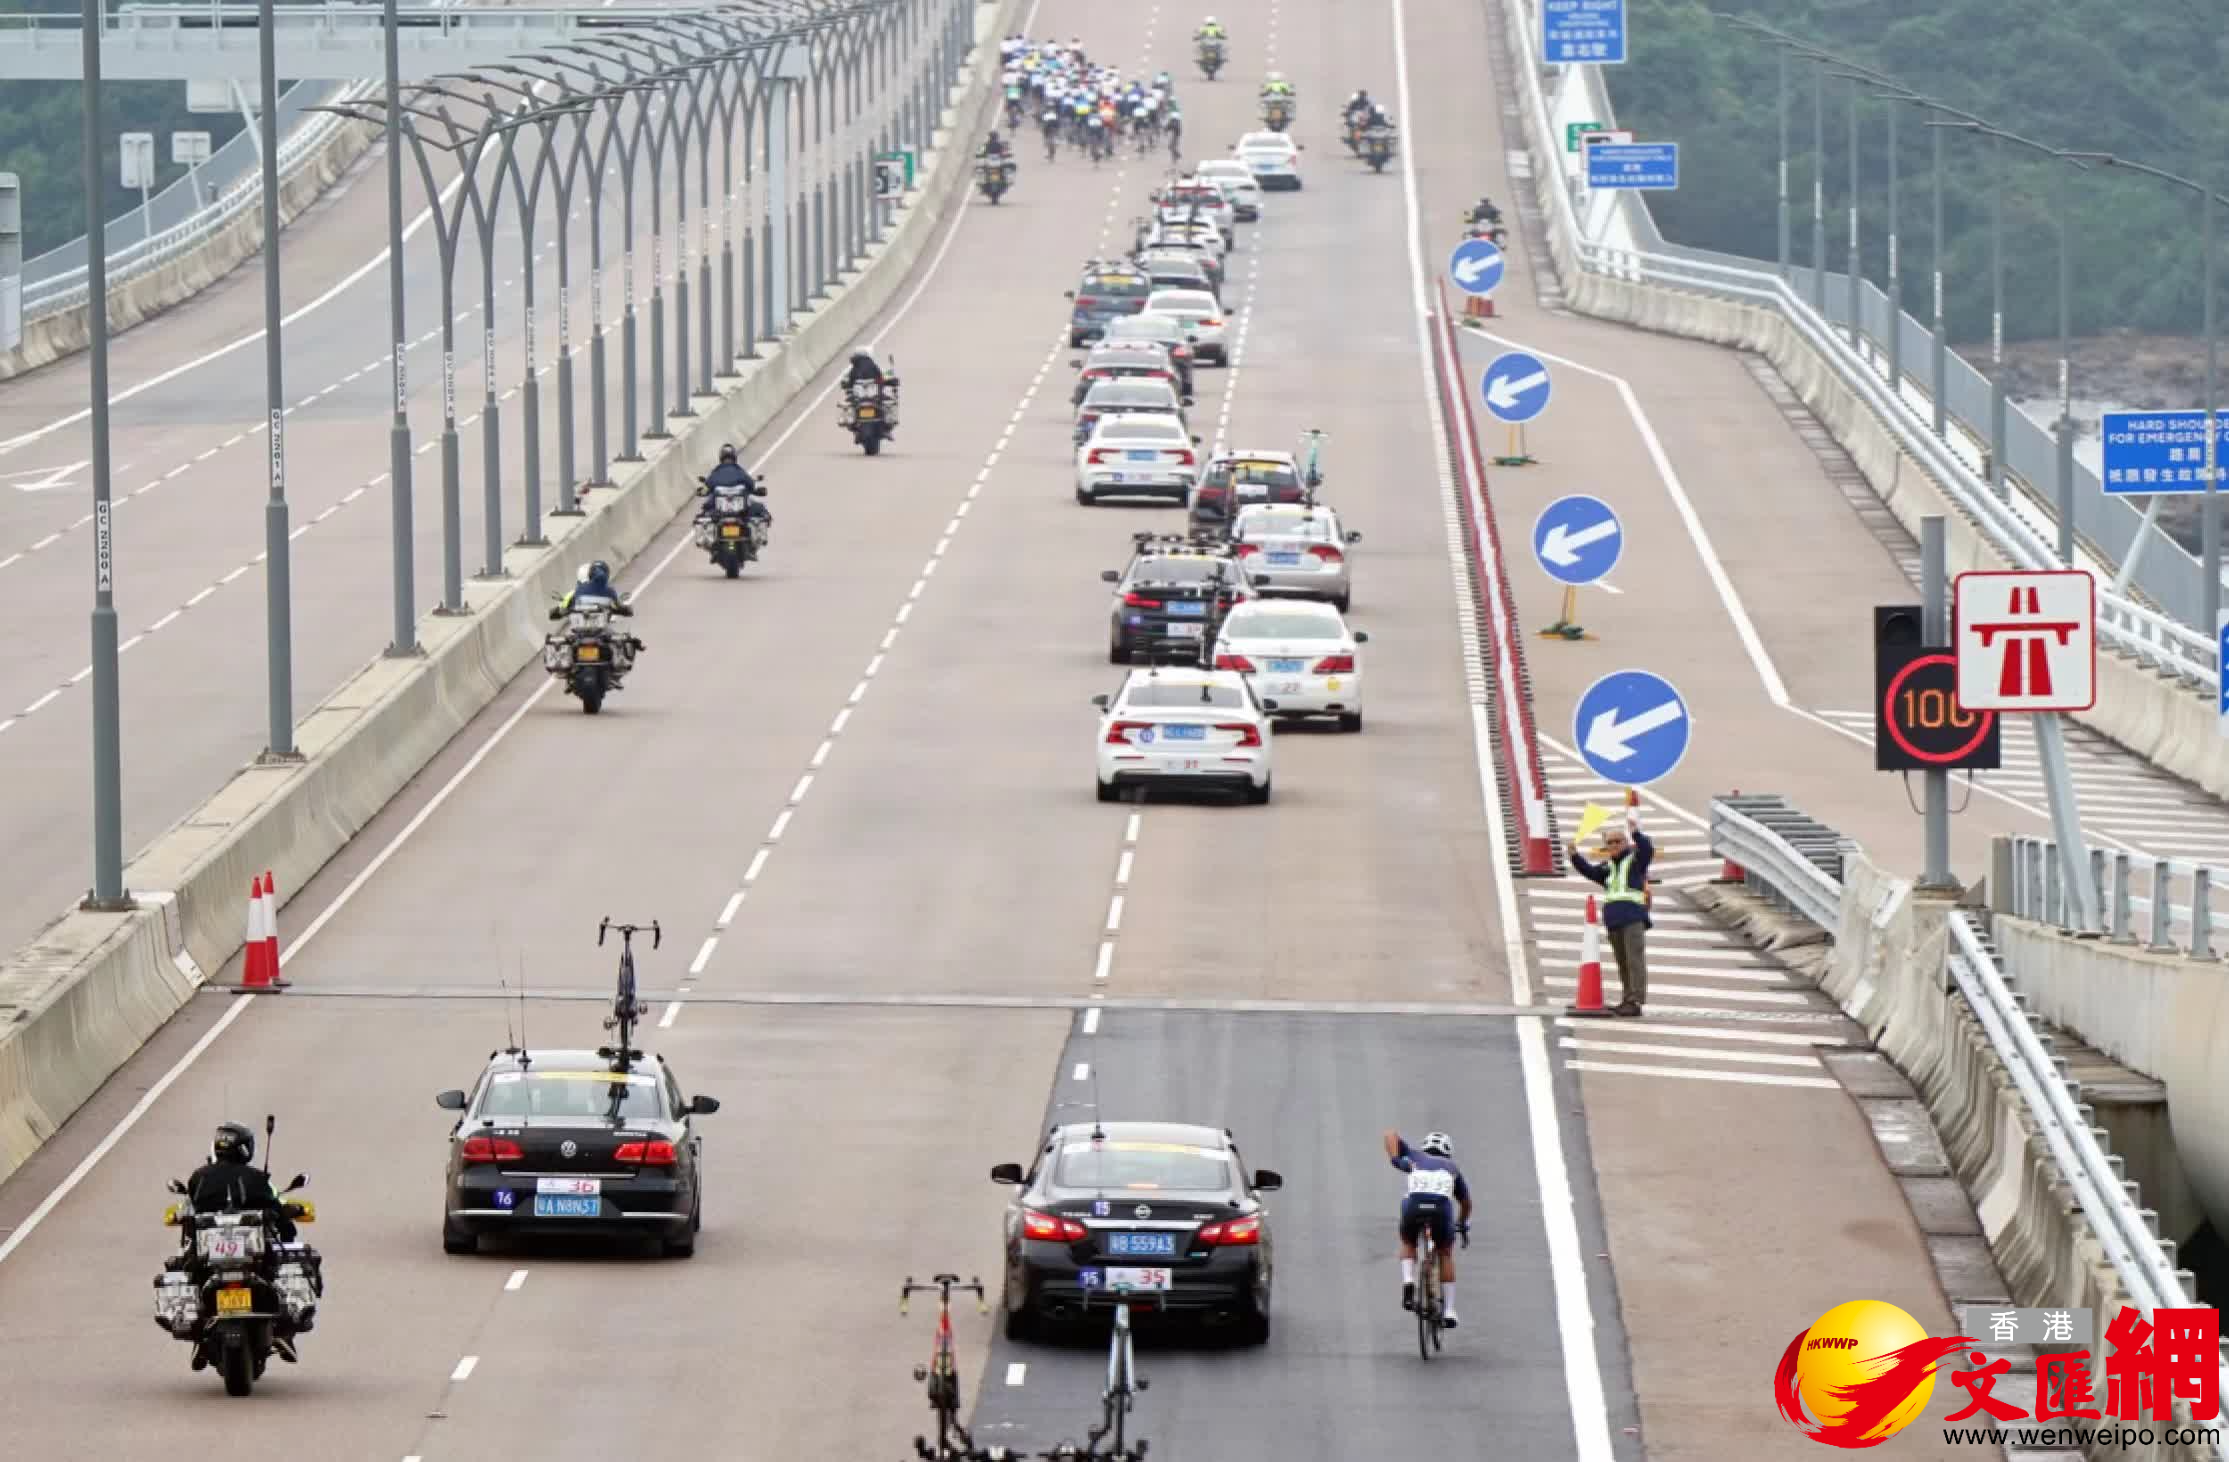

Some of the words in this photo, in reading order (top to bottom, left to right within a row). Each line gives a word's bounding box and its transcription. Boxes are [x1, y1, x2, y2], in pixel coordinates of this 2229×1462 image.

[2127, 420, 2164, 431] HARD
[2108, 433, 2135, 444] FOR
[214, 1240, 238, 1257] 49
[1138, 1270, 1166, 1285] 35
